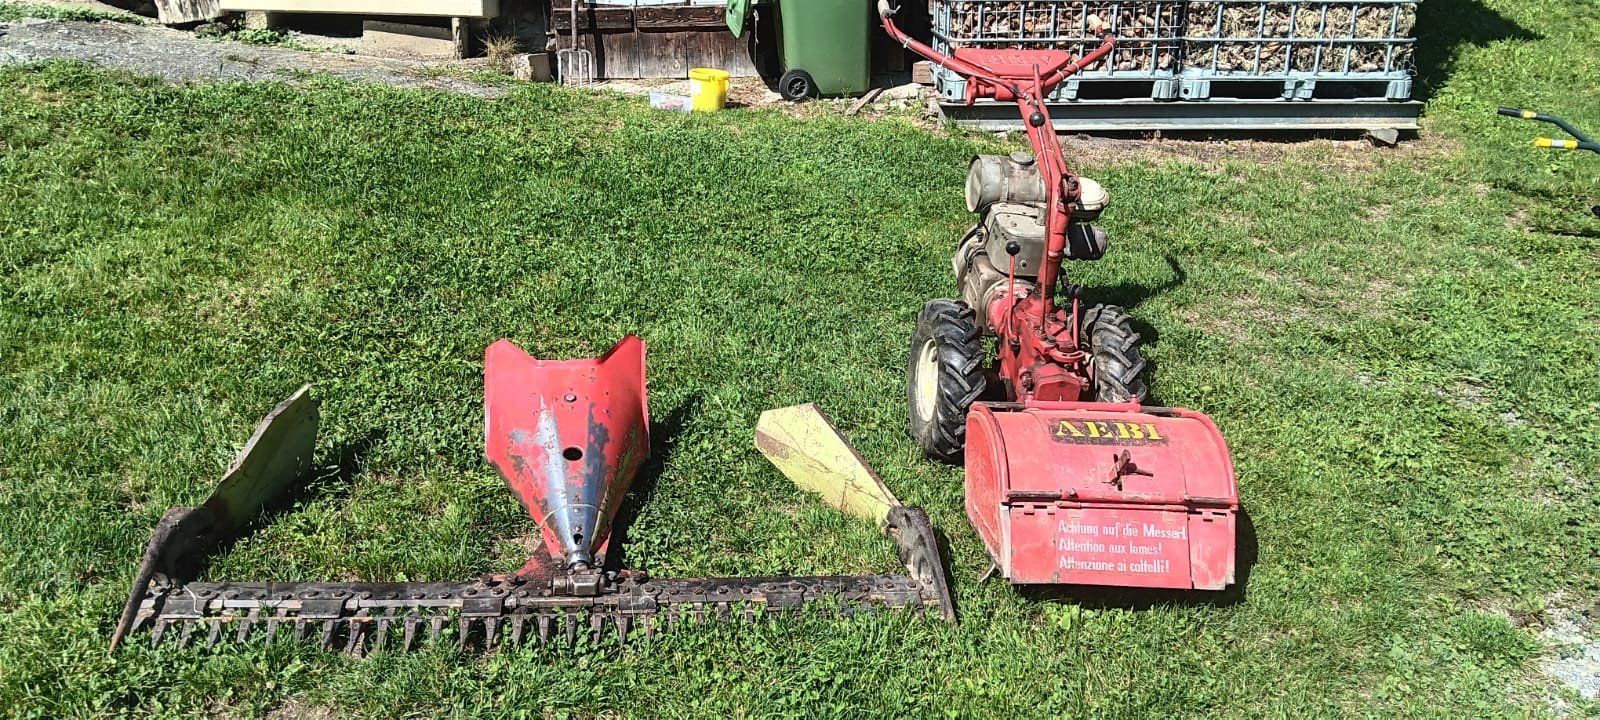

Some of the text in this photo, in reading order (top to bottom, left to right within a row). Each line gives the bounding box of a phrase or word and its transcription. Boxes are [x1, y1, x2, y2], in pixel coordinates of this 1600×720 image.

[1055, 420, 1163, 440] AEBI
[1058, 519, 1187, 540] Achtung auf die Messer!
[1058, 537, 1162, 555] Attention aux lames!
[1059, 555, 1170, 574] Attenzione ai coltelli!
